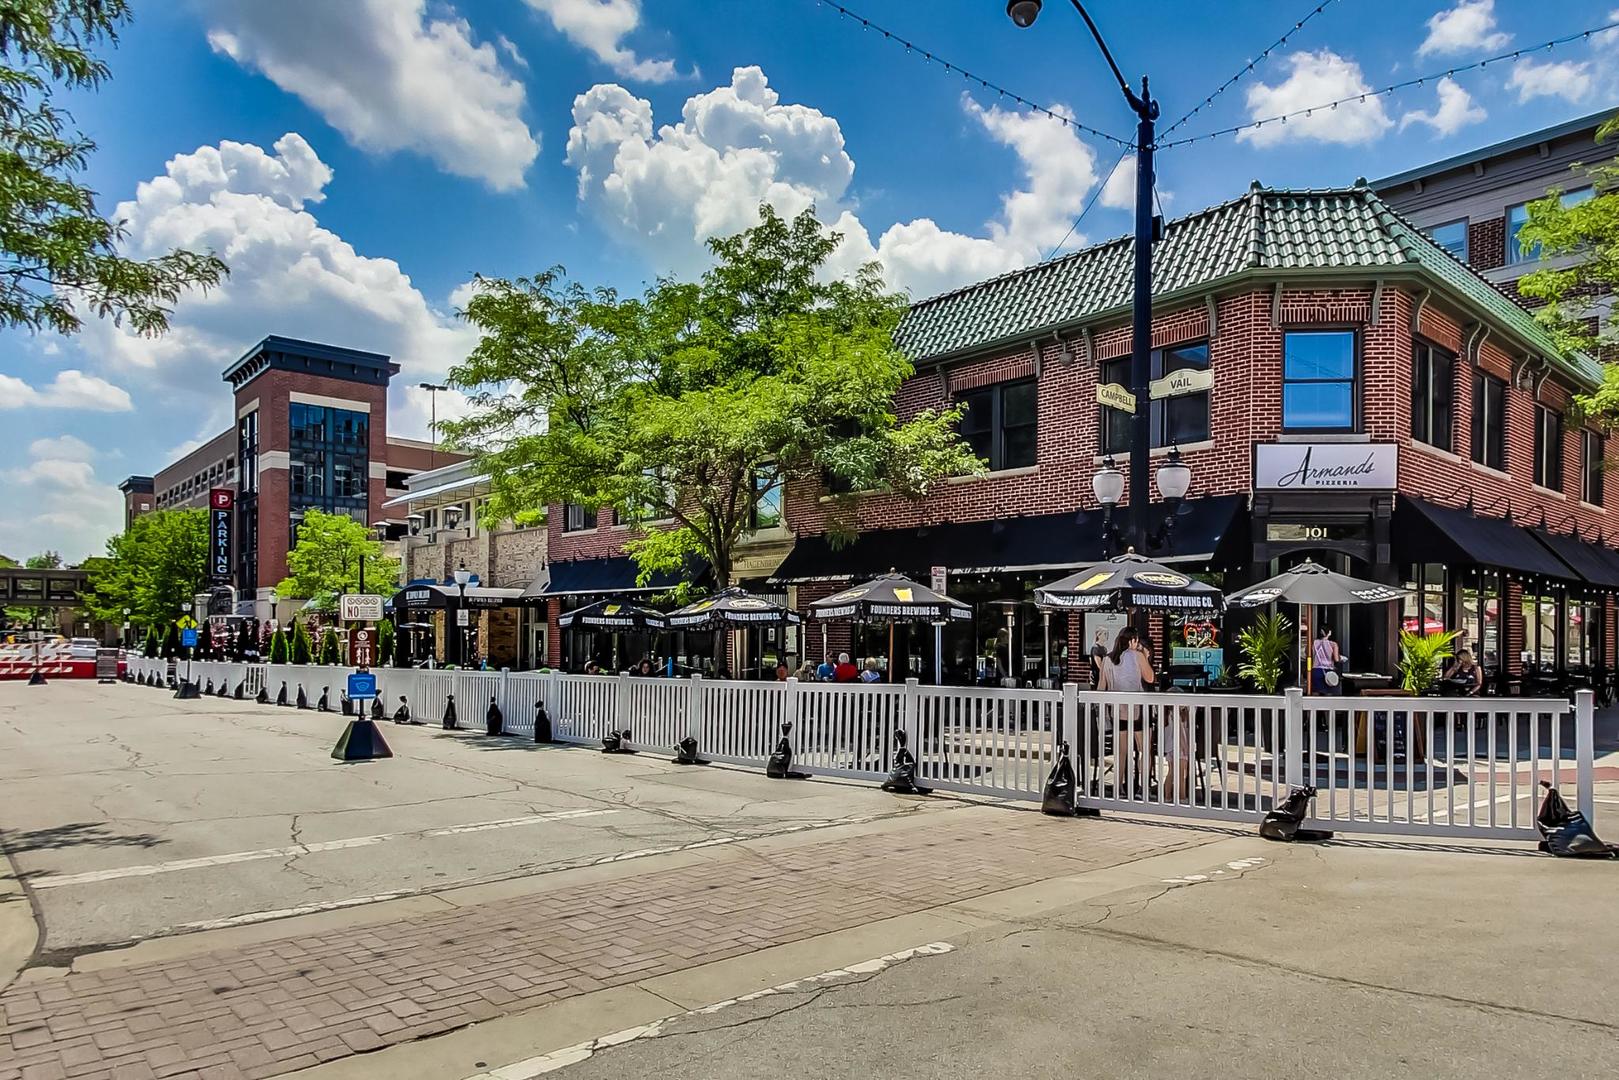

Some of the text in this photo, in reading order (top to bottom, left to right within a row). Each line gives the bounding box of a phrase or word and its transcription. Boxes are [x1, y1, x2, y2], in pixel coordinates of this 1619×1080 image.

[1170, 377, 1192, 389] VAIL
[1101, 388, 1133, 407] CAMPBELL
[1277, 446, 1375, 487] Armands
[218, 494, 229, 505] P
[1305, 527, 1327, 538] 101
[217, 511, 228, 574] PARKING
[1132, 594, 1214, 608] FOUNDERS BREWING CO.
[347, 606, 359, 617] NO
[870, 604, 902, 616] FOUNDERS
[901, 606, 931, 616] BREWING
[930, 606, 942, 616] CO.
[1183, 651, 1212, 664] HELP
